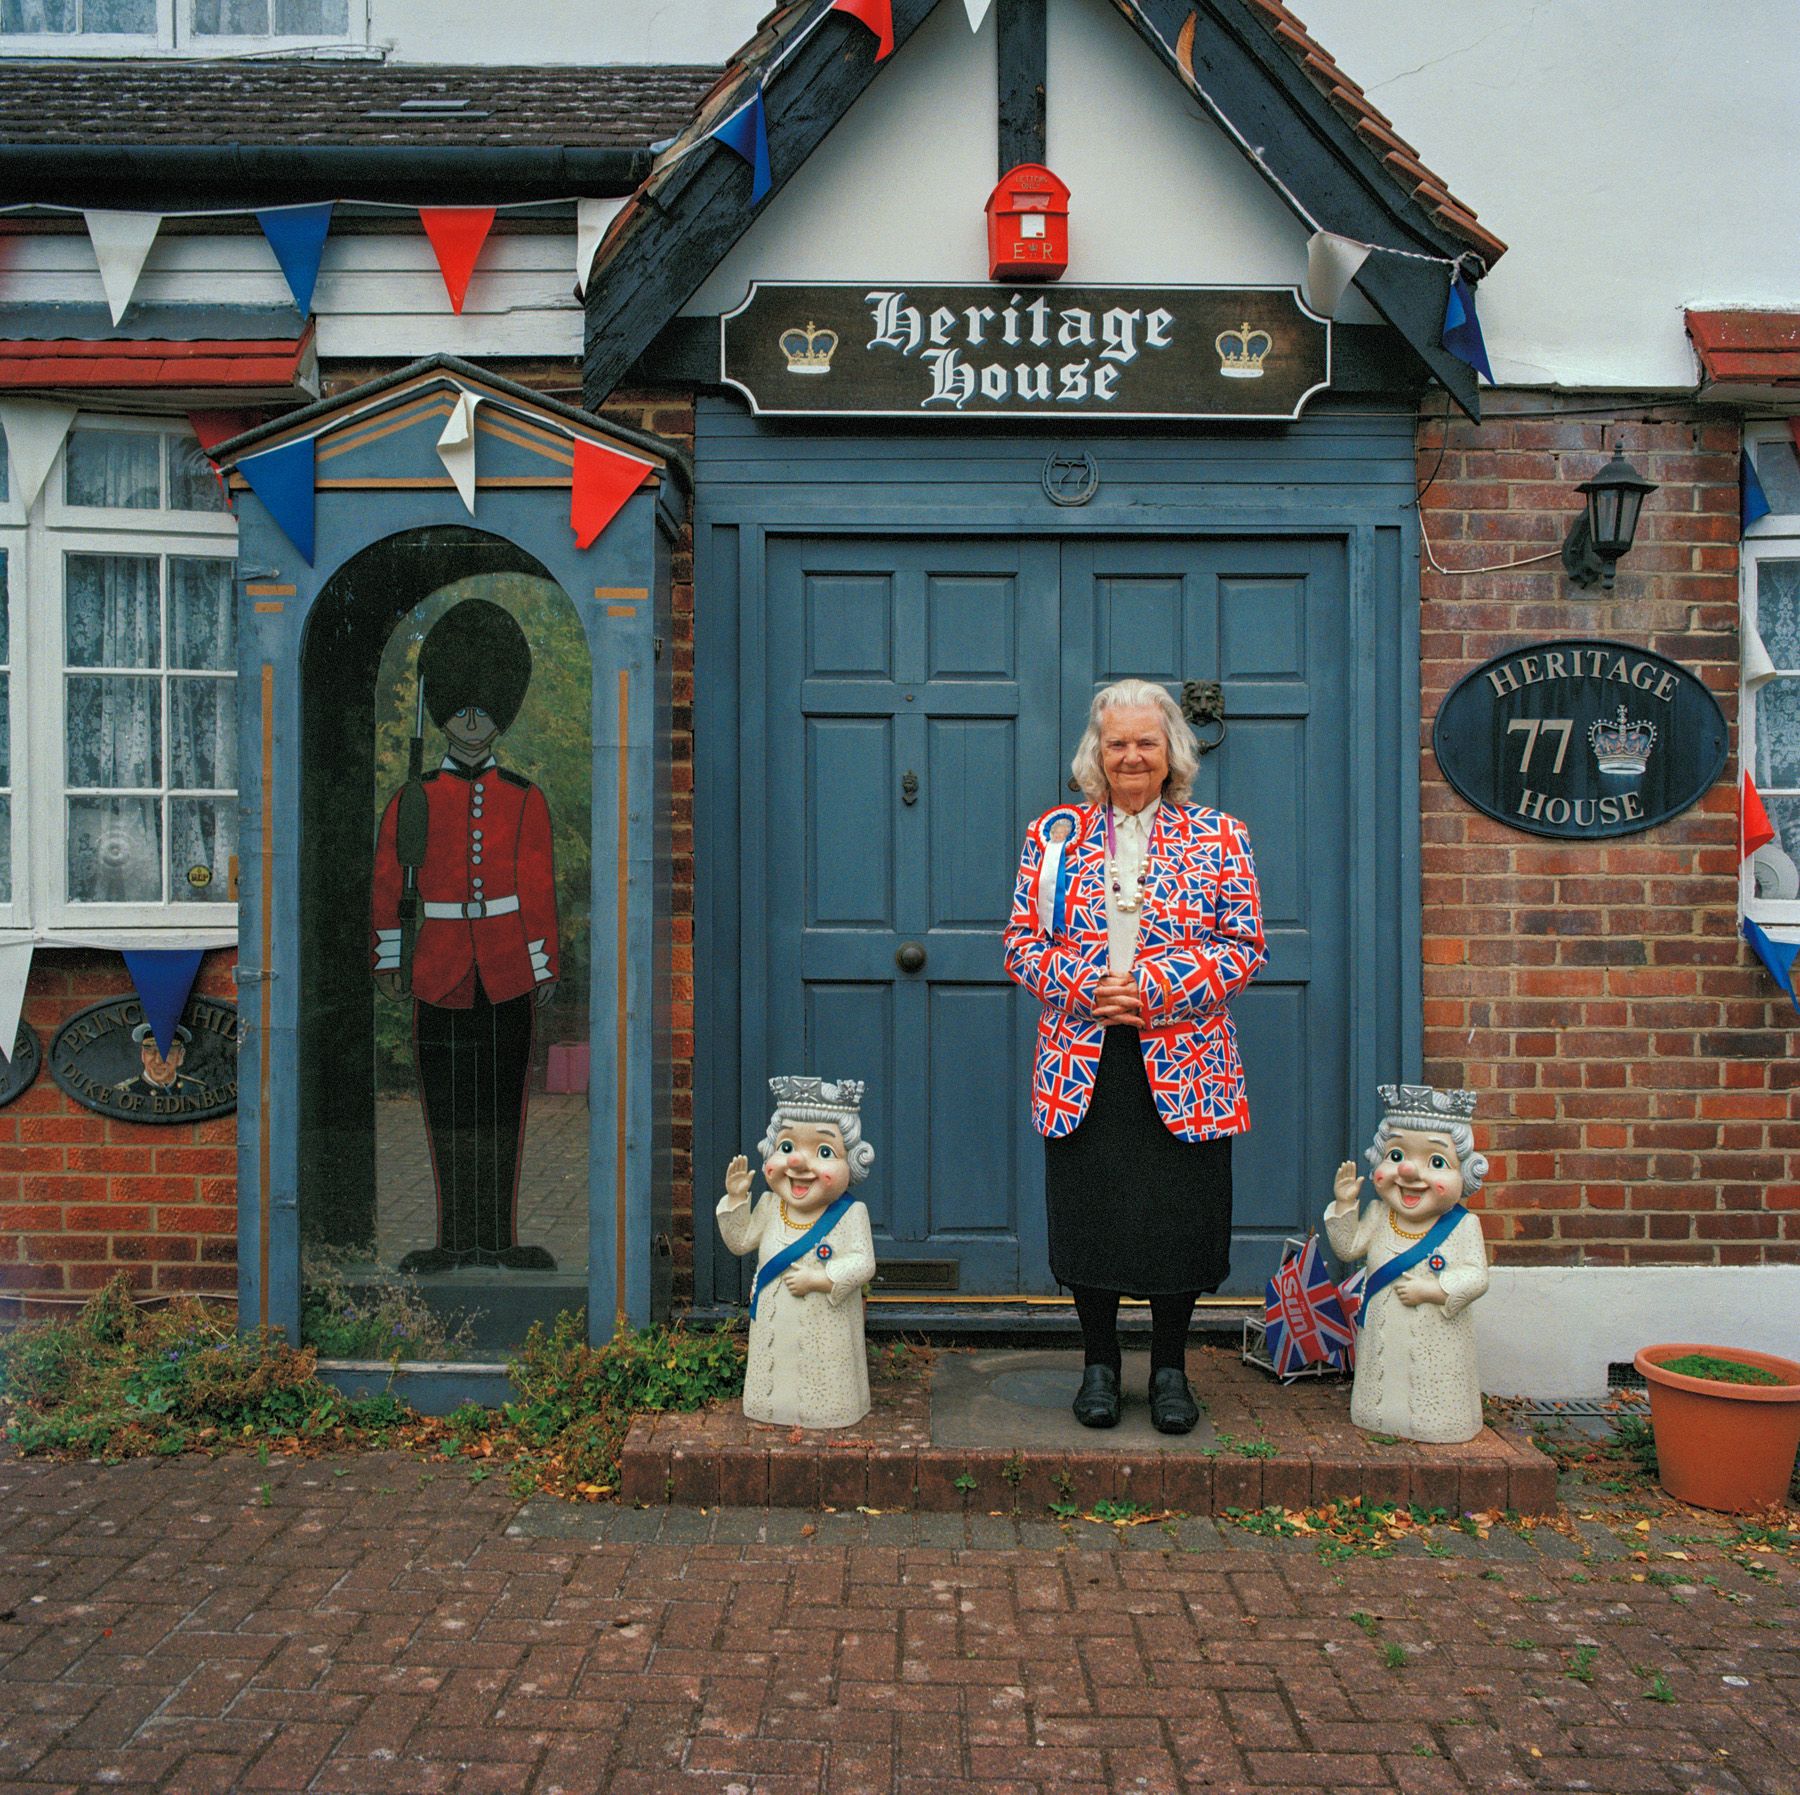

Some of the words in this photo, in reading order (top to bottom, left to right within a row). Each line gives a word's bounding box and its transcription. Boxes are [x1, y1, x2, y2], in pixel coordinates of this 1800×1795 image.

[864, 292, 1176, 366] Heritage
[919, 347, 1120, 410] House
[1486, 650, 1681, 702] HERITAGE
[1506, 719, 1574, 774] 77
[1516, 789, 1644, 827] HOUSE
[63, 1004, 142, 1055] PRINC
[61, 1063, 113, 1104] DUKE
[118, 1094, 144, 1113] OF
[153, 1081, 238, 1114] EDINBUR
